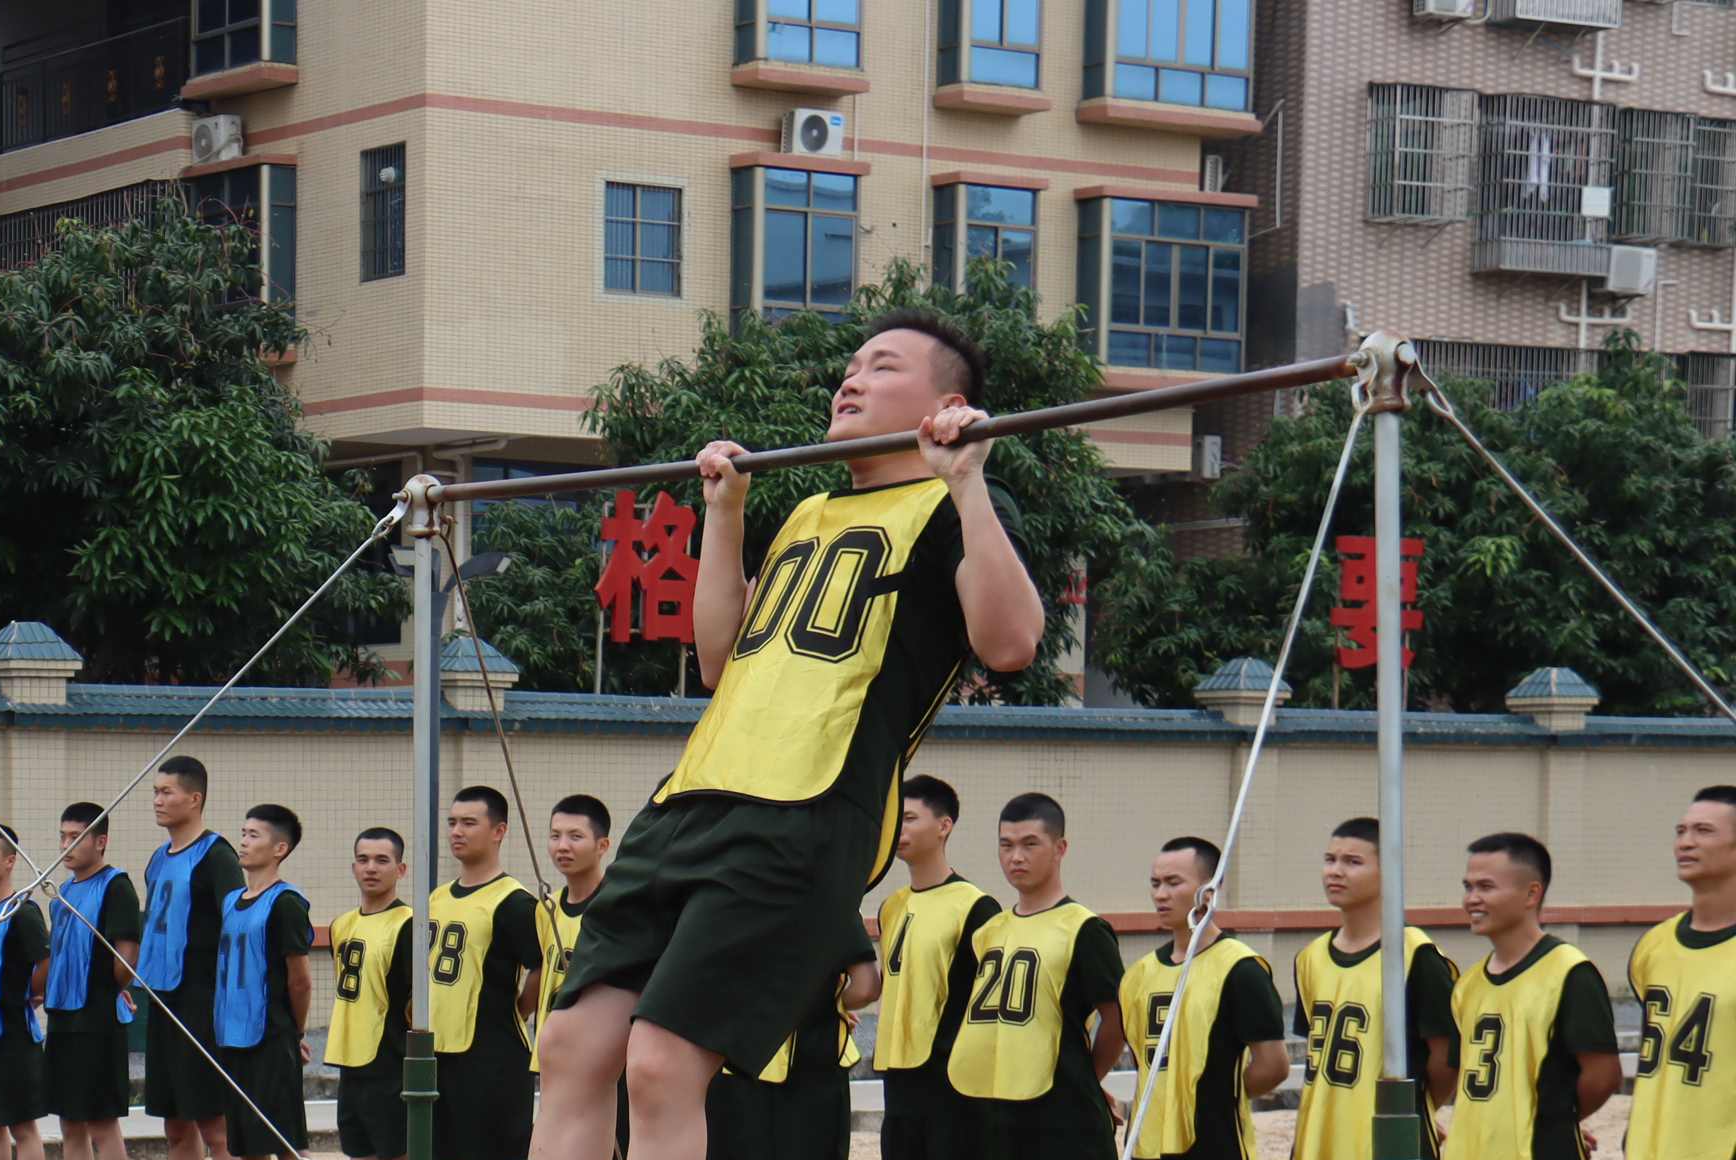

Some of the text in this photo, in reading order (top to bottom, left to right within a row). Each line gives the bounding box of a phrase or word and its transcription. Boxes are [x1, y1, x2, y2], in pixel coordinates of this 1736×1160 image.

[594, 489, 700, 643] 格
[1330, 535, 1425, 669] 要
[967, 946, 1041, 1026] 20
[1464, 1013, 1505, 1101] 3
